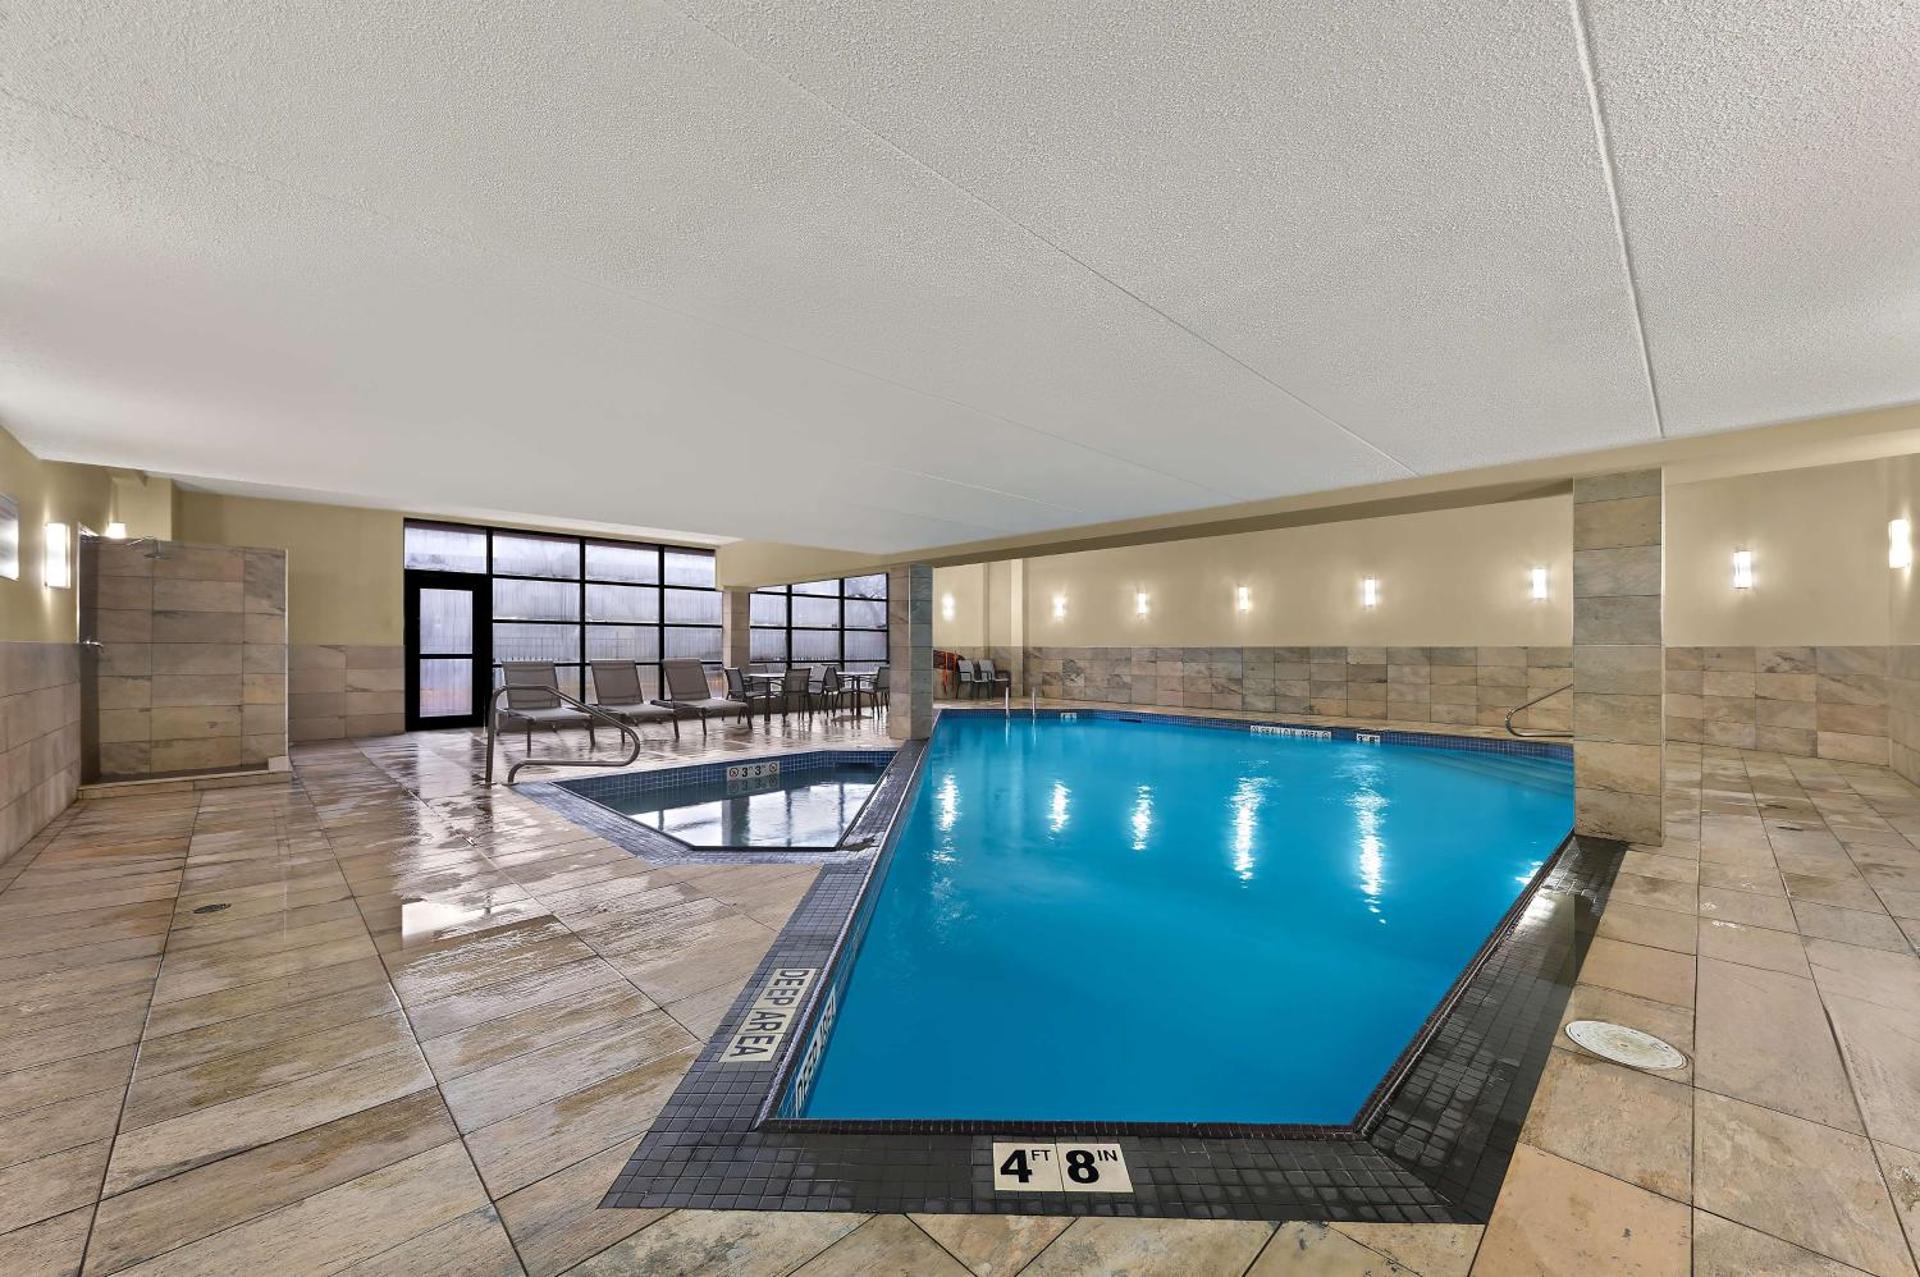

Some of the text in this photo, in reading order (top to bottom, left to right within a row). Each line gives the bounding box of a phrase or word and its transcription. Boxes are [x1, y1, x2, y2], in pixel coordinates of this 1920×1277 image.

[729, 969, 809, 1058] DEEP AREA
[1000, 1149, 1119, 1184] 4 FT 8 IN
